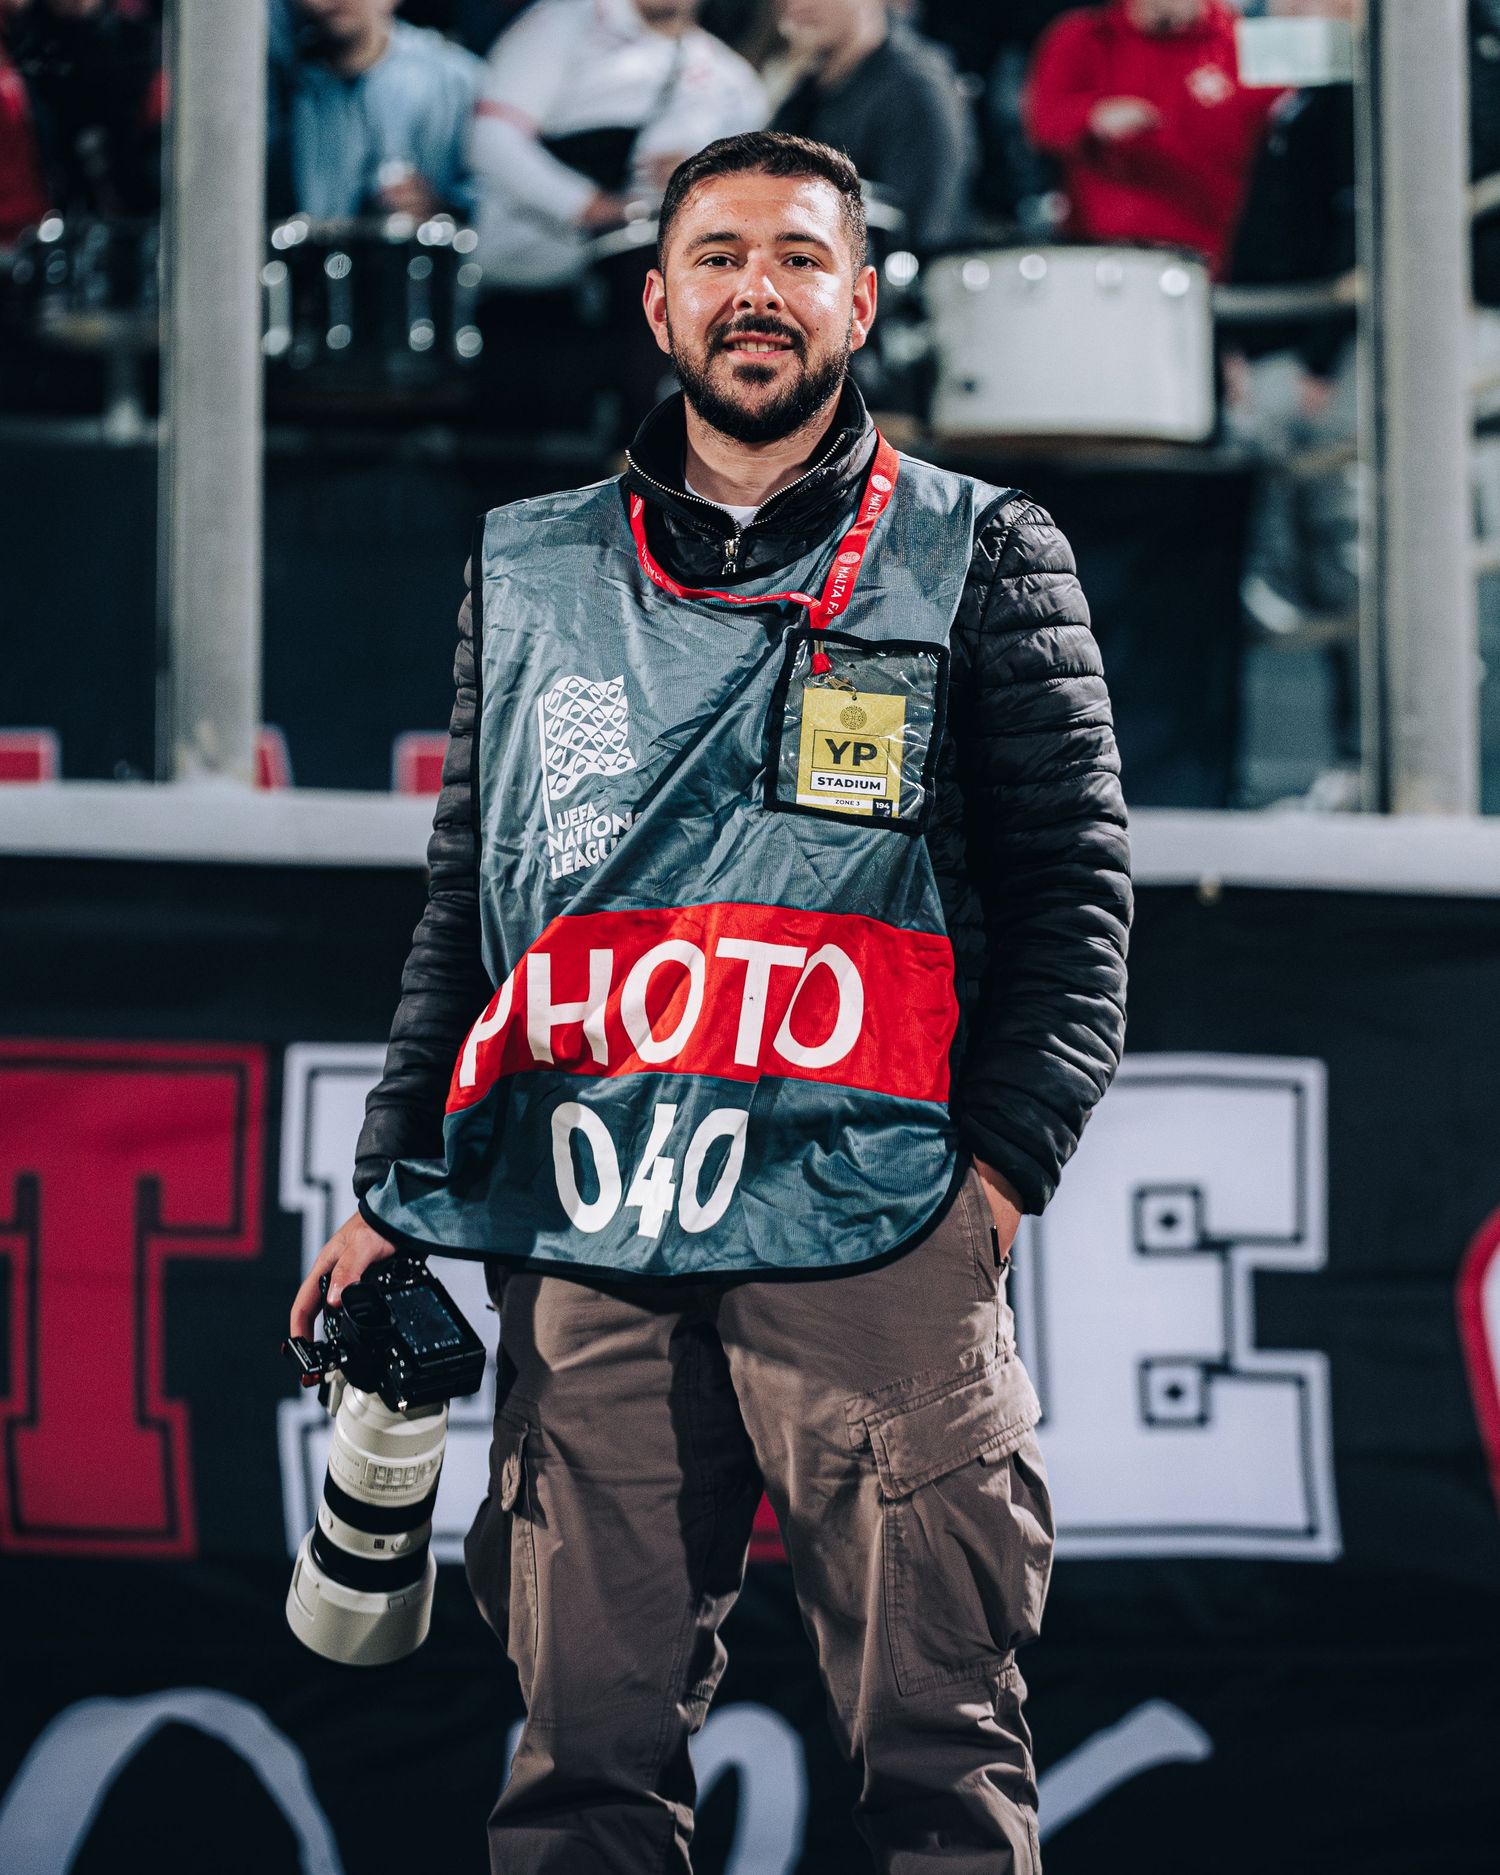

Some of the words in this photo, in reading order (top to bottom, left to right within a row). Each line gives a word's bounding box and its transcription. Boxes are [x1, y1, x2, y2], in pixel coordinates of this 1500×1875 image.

[831, 566, 850, 598] MALTA
[825, 601, 839, 615] FA
[825, 738, 878, 767] YP
[817, 776, 881, 791] STADIUM
[556, 802, 598, 830] UEFA
[875, 802, 890, 810] 194
[547, 812, 642, 858] NATION
[550, 838, 620, 880] LEAGU
[458, 937, 864, 1088] PHOTO
[551, 1102, 749, 1239] 040
